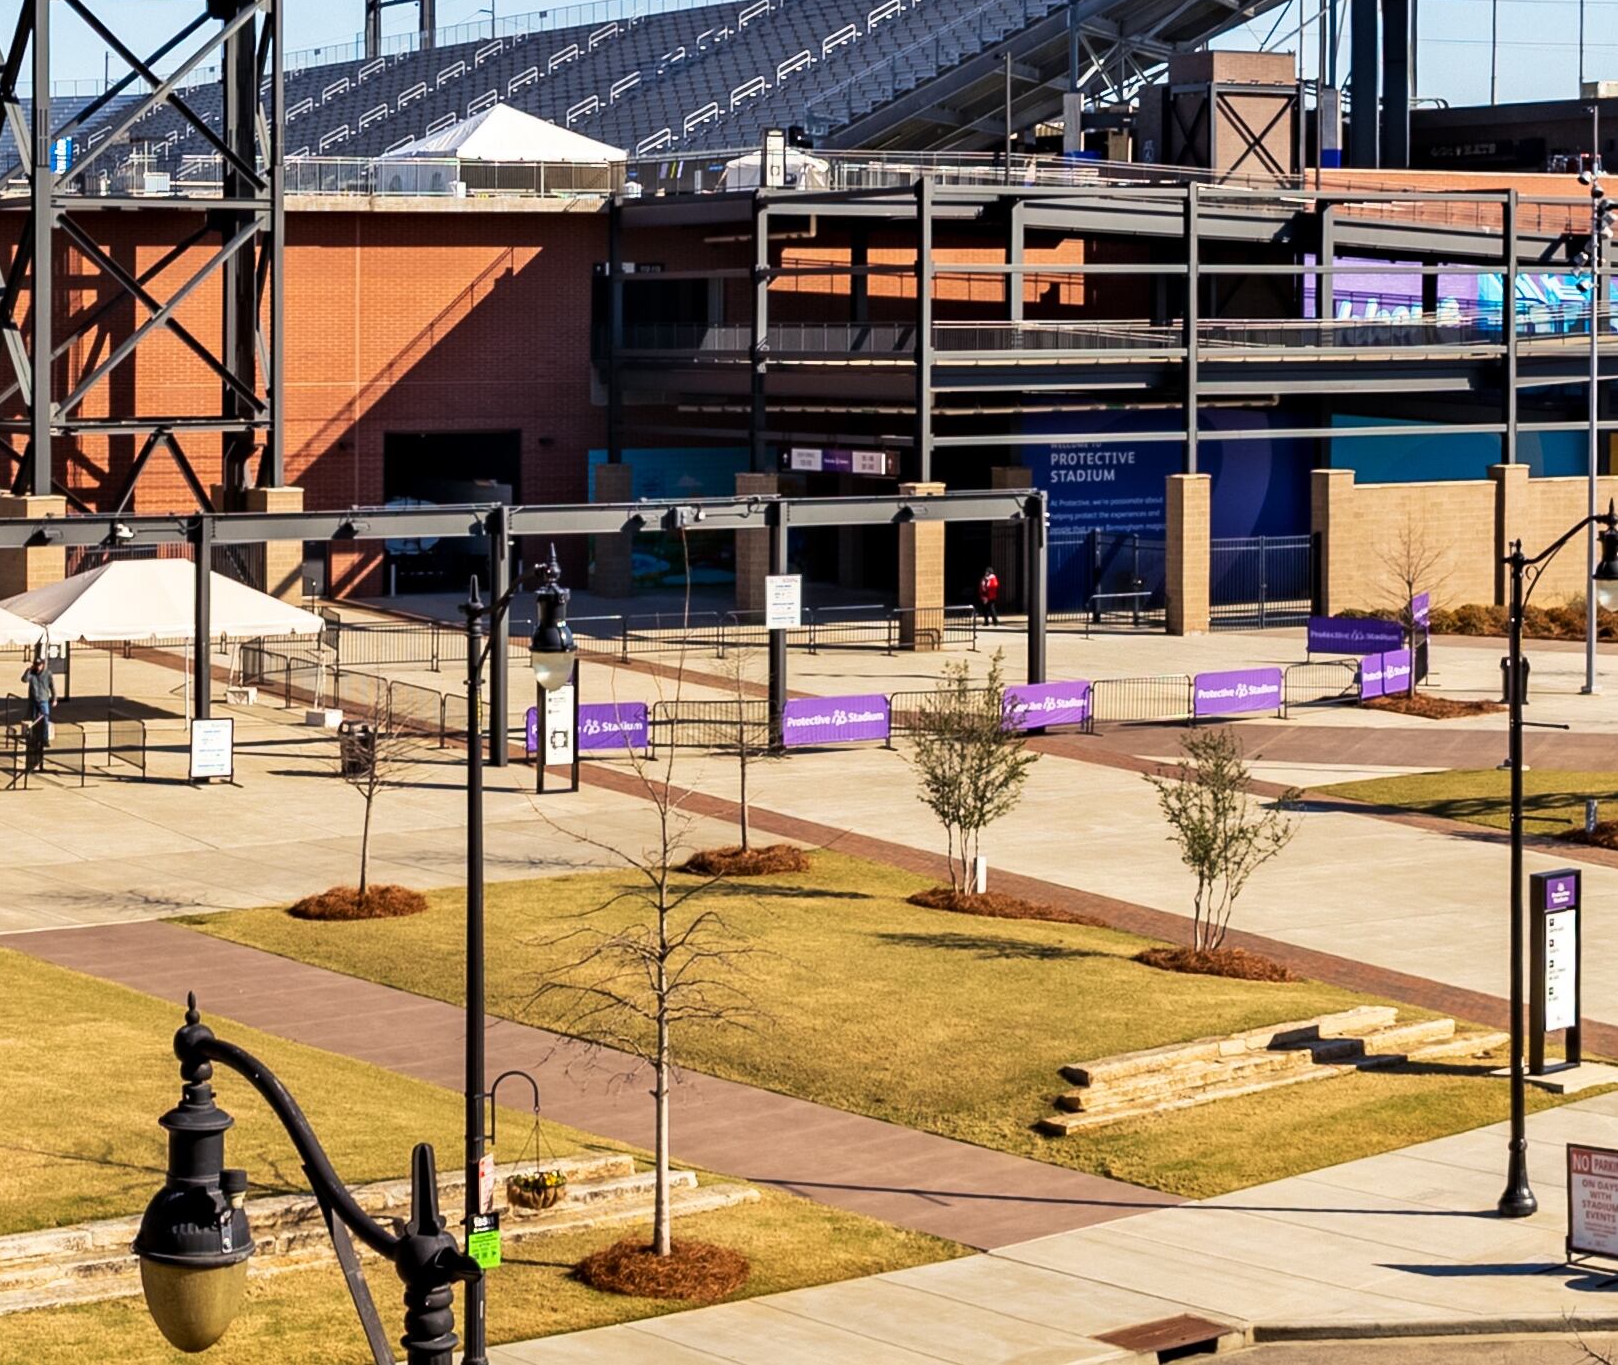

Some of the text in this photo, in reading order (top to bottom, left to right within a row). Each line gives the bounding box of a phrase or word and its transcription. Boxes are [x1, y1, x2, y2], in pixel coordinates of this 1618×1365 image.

[1050, 451, 1136, 466] PROTECTIVE
[1050, 468, 1116, 483] STADIUM
[1197, 683, 1279, 700] Protective Stadium
[786, 710, 885, 728] Protective Stadium
[1572, 1153, 1590, 1172] NO
[1582, 1179, 1595, 1189] ON
[1589, 1190, 1612, 1201] WITH
[1585, 1210, 1617, 1223] EVENTS
